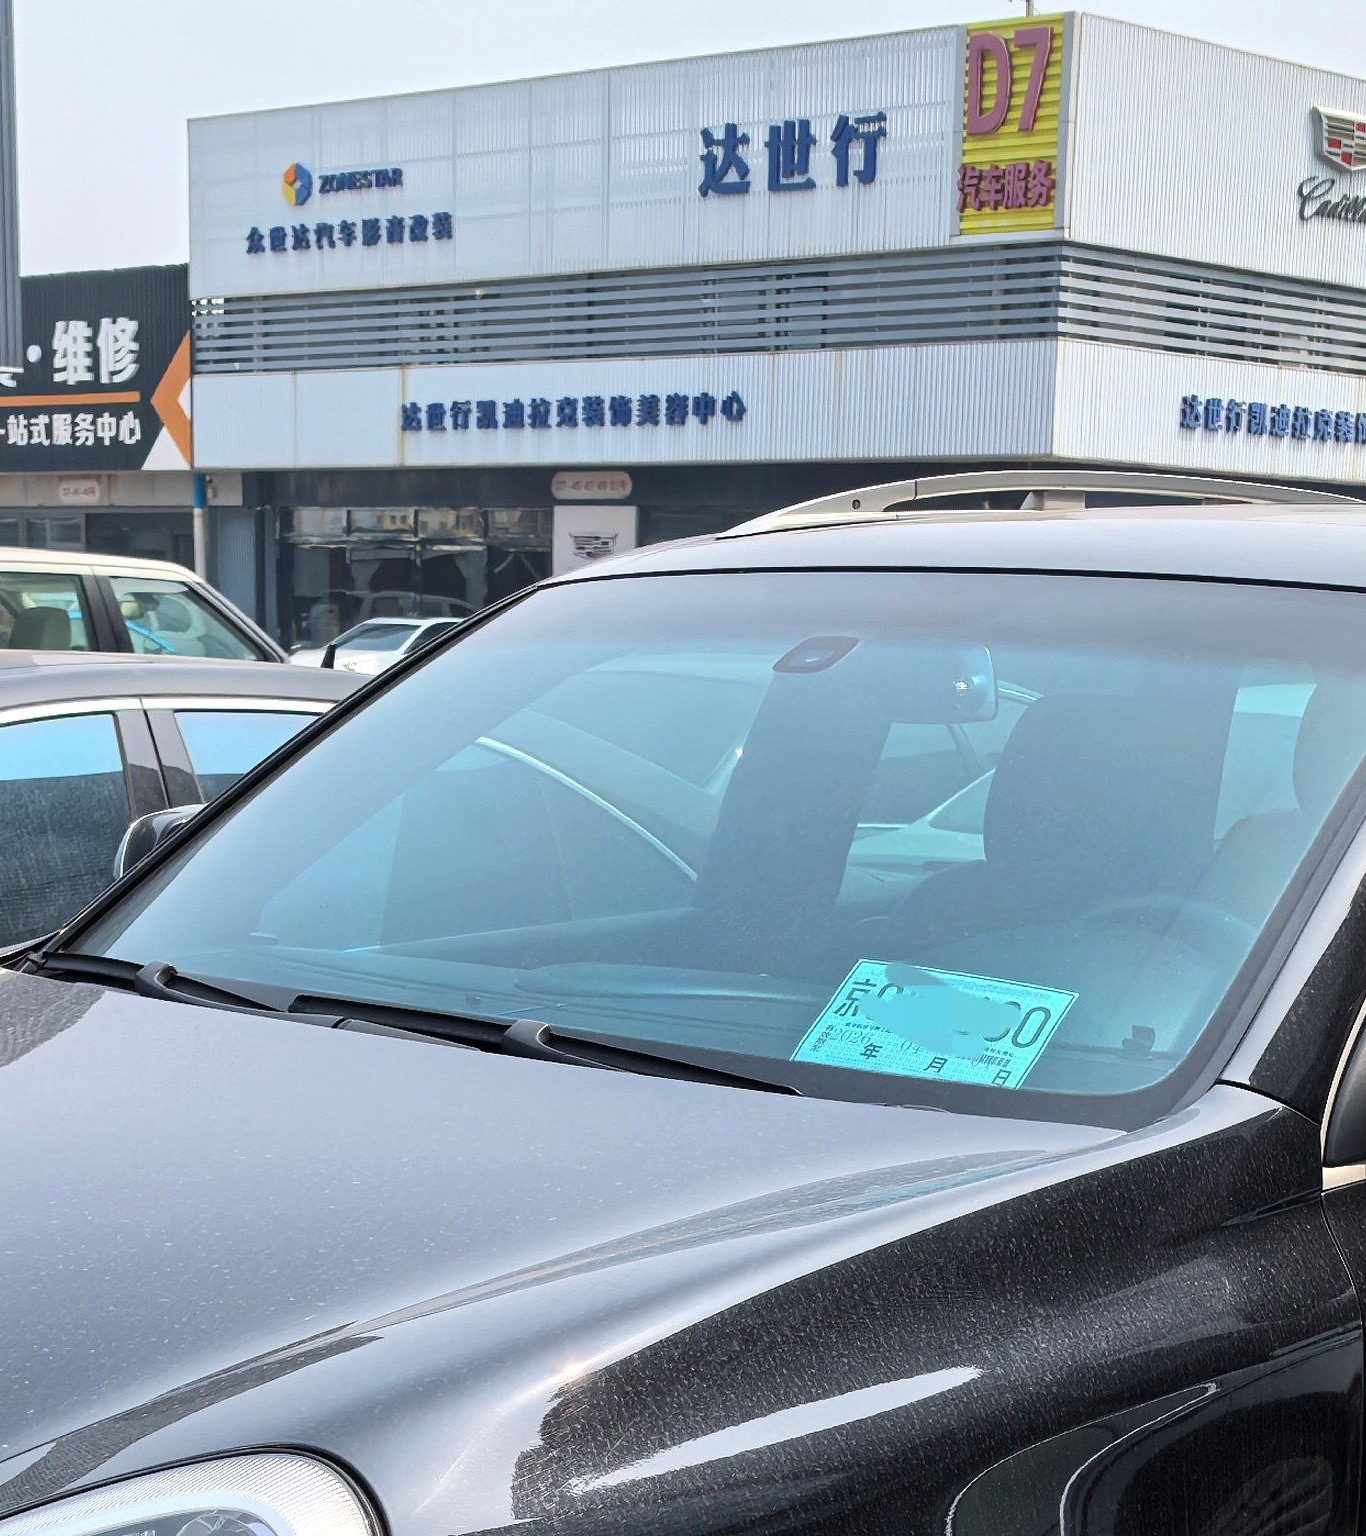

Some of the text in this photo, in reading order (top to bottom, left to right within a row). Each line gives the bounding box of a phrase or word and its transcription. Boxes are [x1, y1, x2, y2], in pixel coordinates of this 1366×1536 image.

[965, 26, 1054, 137] D7
[698, 111, 887, 197] 达世行
[318, 168, 403, 194] ZONESTAR
[956, 160, 1056, 213] 汽车服务
[401, 391, 747, 431] 达世行凯迪拉克装饰美容中心
[860, 1042, 882, 1060] 年
[923, 1056, 948, 1074] 月
[992, 1069, 1013, 1086] 日
